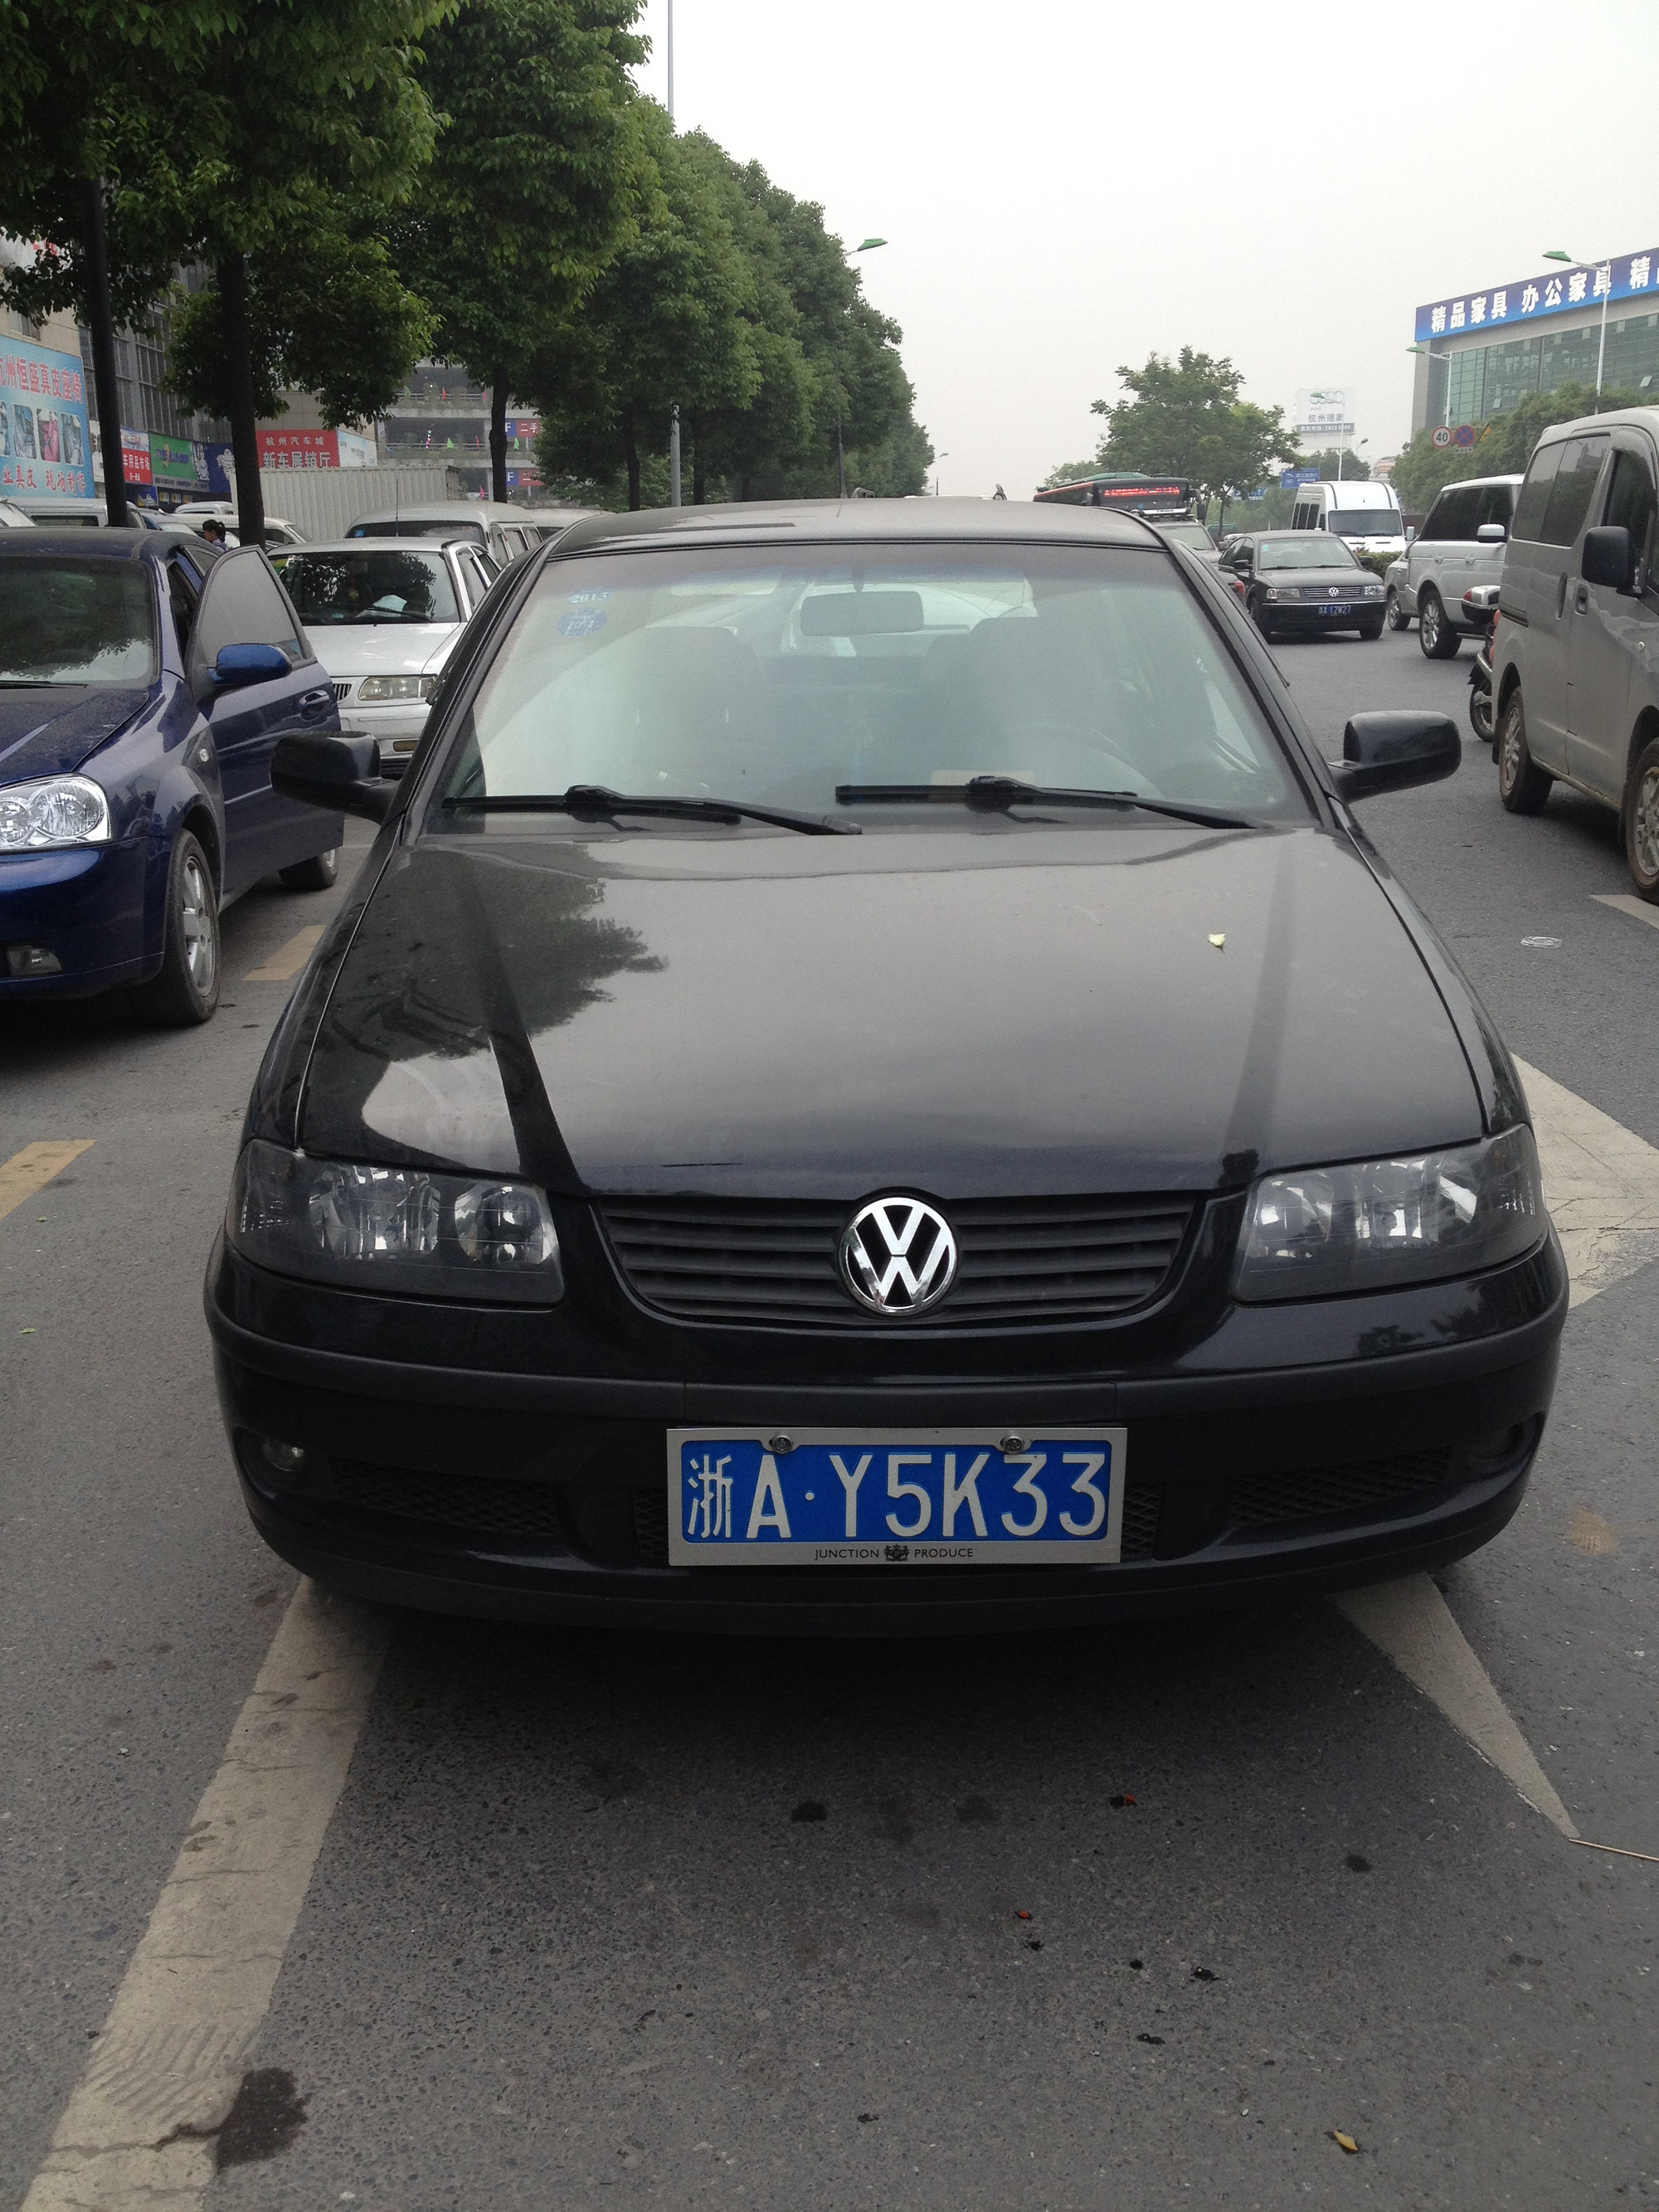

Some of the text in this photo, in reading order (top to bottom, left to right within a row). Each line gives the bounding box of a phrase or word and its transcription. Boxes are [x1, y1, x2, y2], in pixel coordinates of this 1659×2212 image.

[1431, 255, 1659, 333] 精品家具 办公家具 精
[265, 435, 324, 446] 杭州汽车城
[1436, 432, 1448, 442] 40
[263, 450, 331, 469] 新车展销厅
[815, 1548, 974, 1560] JUNCTION PRODUCE
